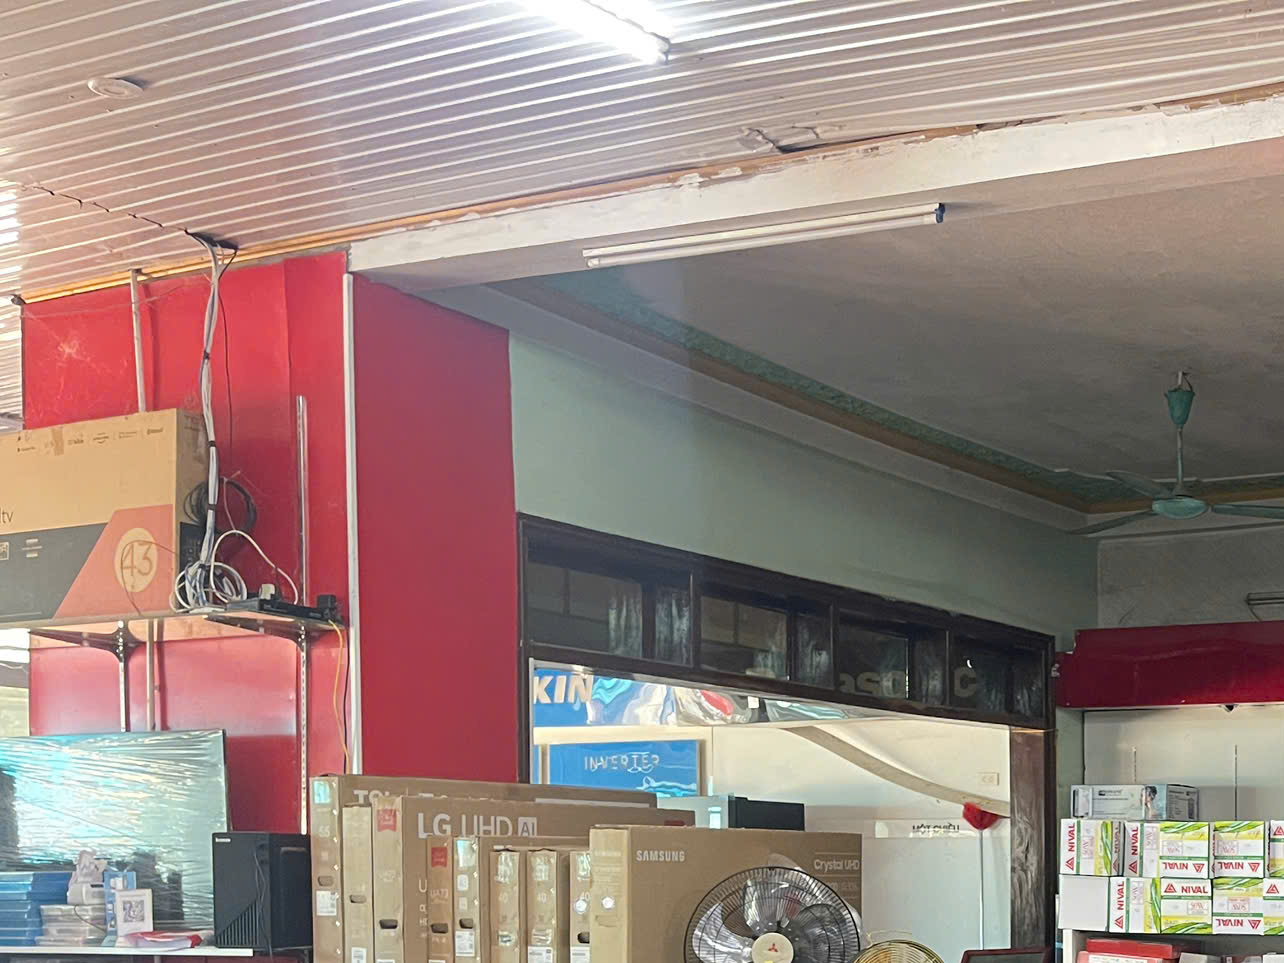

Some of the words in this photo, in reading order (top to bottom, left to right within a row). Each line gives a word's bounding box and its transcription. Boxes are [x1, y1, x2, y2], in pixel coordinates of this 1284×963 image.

[120, 542, 154, 577] 43
[417, 812, 451, 839] LG
[461, 815, 513, 838] UHD
[1067, 823, 1076, 852] NIVAL
[1131, 826, 1139, 856] NIVAL
[636, 850, 685, 862] SAMSUNG
[813, 858, 843, 872] Crystal
[845, 859, 860, 871] UHD
[1117, 881, 1125, 911] NIVAL
[1181, 885, 1209, 894] NIVAL
